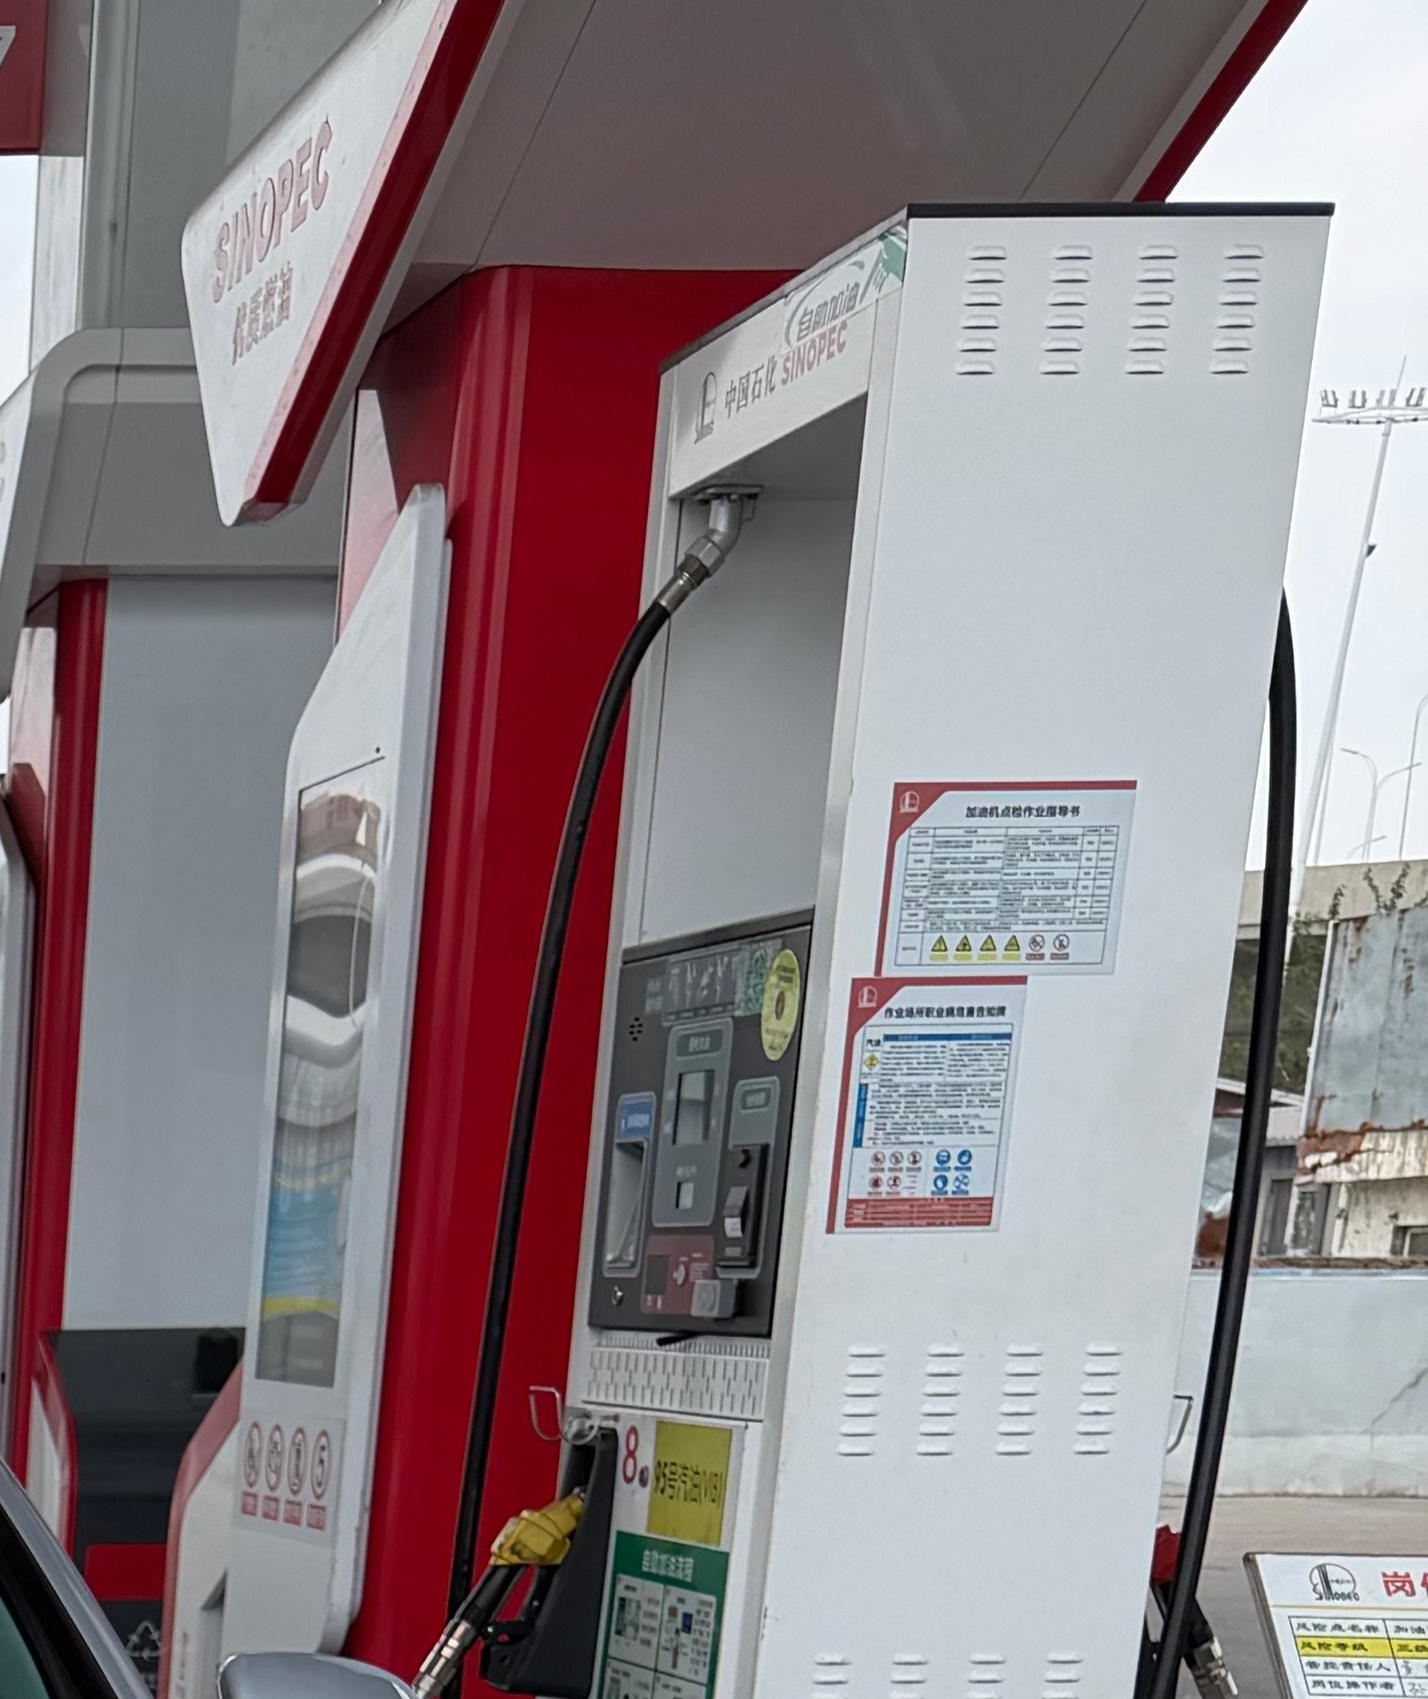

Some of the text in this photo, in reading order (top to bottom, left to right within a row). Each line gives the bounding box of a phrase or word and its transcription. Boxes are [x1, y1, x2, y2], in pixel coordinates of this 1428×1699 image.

[212, 117, 333, 304] SINOPEC
[724, 319, 849, 420] 中国石化 SINOPEC
[965, 804, 1082, 819] 加油机点检作业指导书
[622, 1424, 640, 1485] 8
[1381, 1570, 1428, 1598] 岗
[1394, 1624, 1428, 1635] 加油
